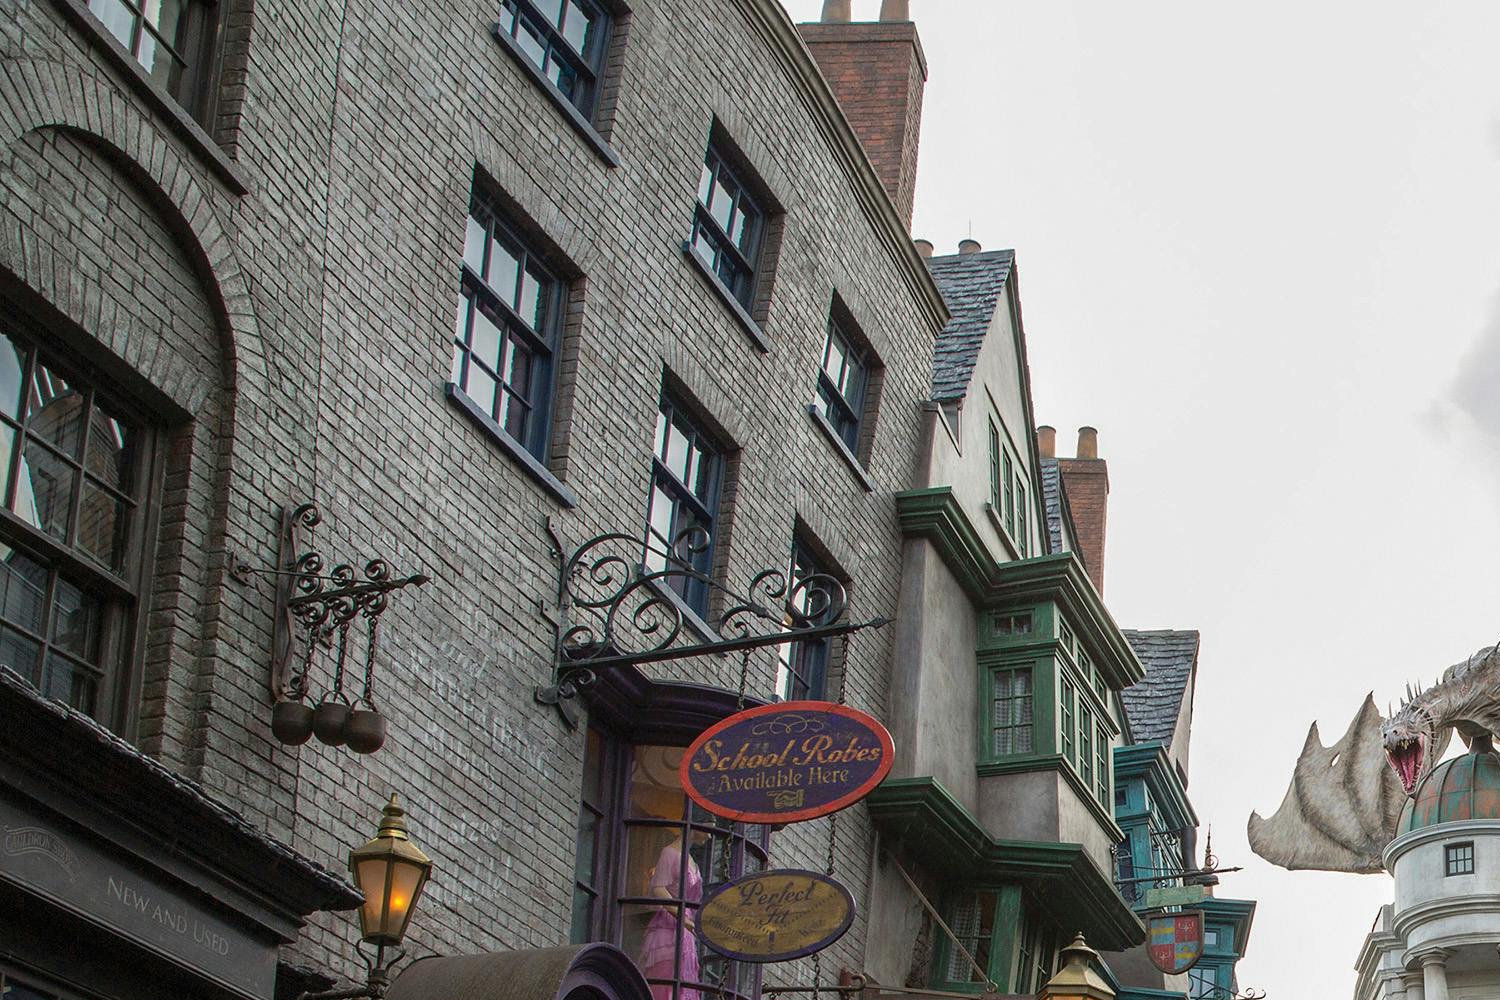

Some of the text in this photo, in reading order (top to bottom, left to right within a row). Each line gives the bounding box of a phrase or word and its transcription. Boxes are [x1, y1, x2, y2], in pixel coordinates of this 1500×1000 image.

[694, 734, 882, 773] School Robes
[717, 767, 850, 793] Available Here
[739, 879, 816, 907] Perfect
[106, 876, 229, 957] NEW AND USED
[759, 905, 790, 926] Fit
